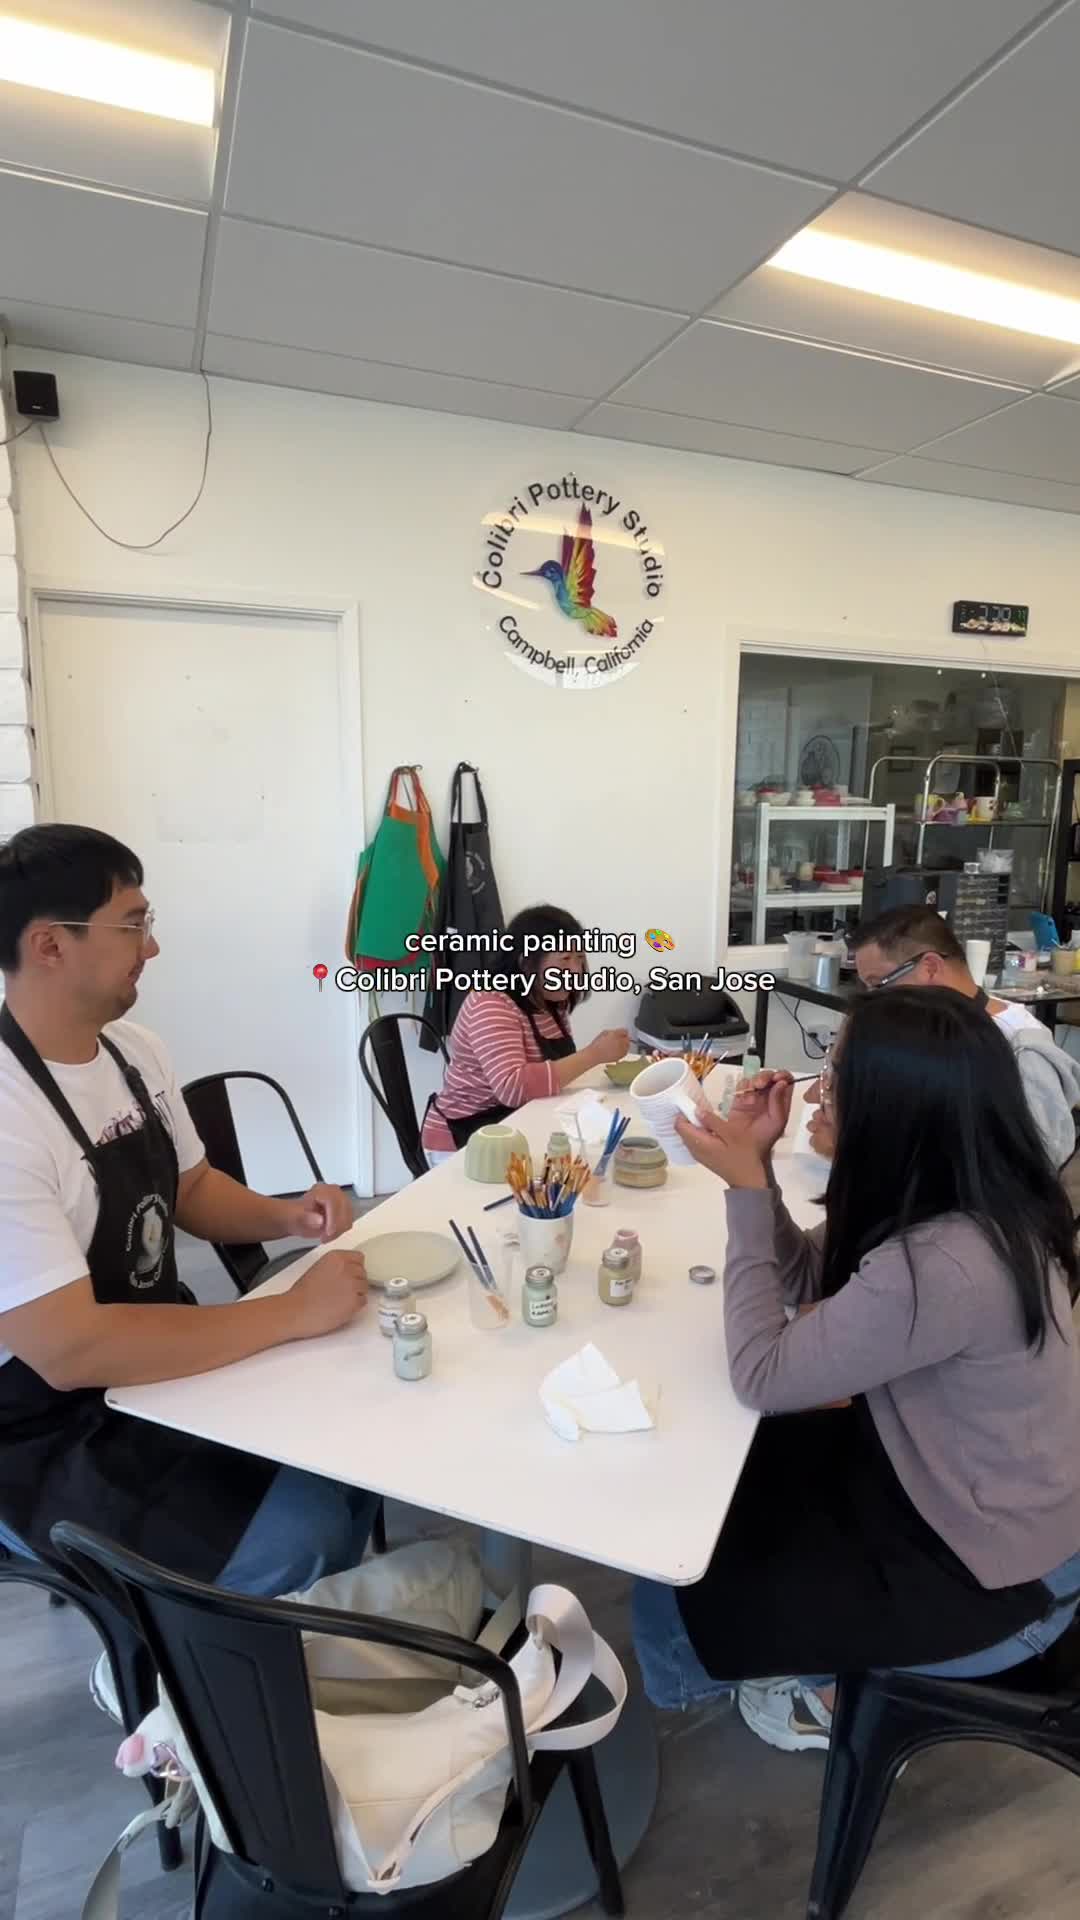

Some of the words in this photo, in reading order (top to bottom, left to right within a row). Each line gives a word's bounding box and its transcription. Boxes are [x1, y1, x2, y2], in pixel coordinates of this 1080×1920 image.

[482, 496, 529, 589] Colibri
[527, 477, 620, 515] Pottery
[623, 510, 664, 598] Studio
[499, 615, 580, 677] Campbell,
[584, 619, 654, 674] California
